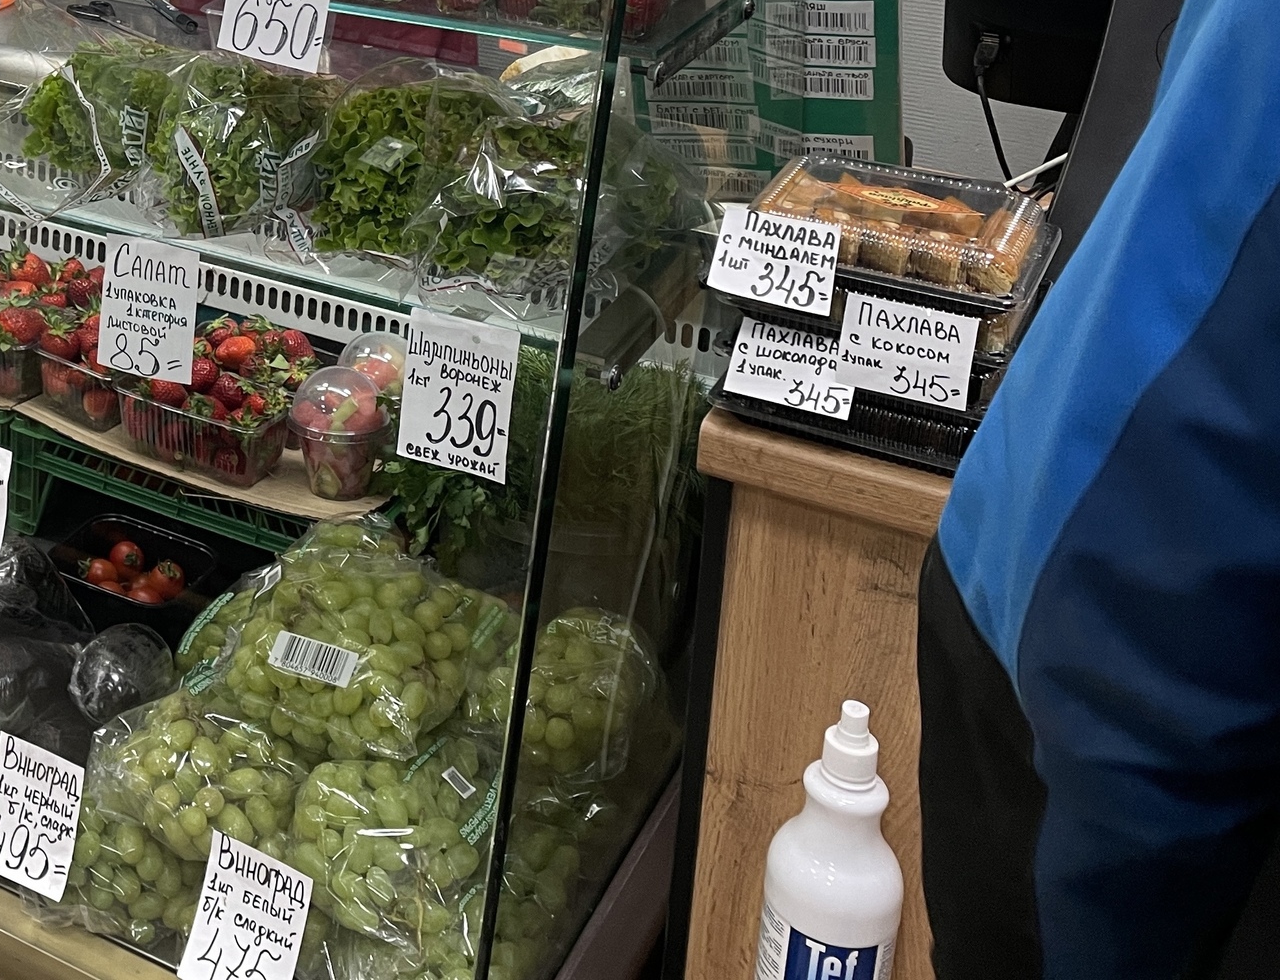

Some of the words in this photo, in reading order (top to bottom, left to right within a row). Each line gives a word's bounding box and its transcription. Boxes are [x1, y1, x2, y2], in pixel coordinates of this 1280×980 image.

[744, 210, 836, 251] ПАХЛАВА
[114, 243, 190, 289] САЛАТ
[738, 234, 836, 271] МИНДАЛЕМ
[106, 315, 167, 340] ЛИСТОВОЙ
[751, 322, 840, 356] ПАХЛАВА
[858, 302, 961, 344] ПАХЛАВА
[408, 328, 513, 382] ШАМПИНЬОНЫ
[872, 337, 950, 364] КОКОСОМ
[440, 363, 502, 394] ВОРОНЕЖ
[406, 442, 442, 463] СВЕЖ
[447, 452, 500, 477] УРОЖАЙ
[3, 735, 80, 803] ВИНОГРАД
[24, 785, 76, 820] ЧЕРНЫЙ
[218, 833, 305, 910] ВИНОГРАД
[242, 890, 295, 924] БЕЛЫЙ
[233, 913, 297, 951] сладкий
